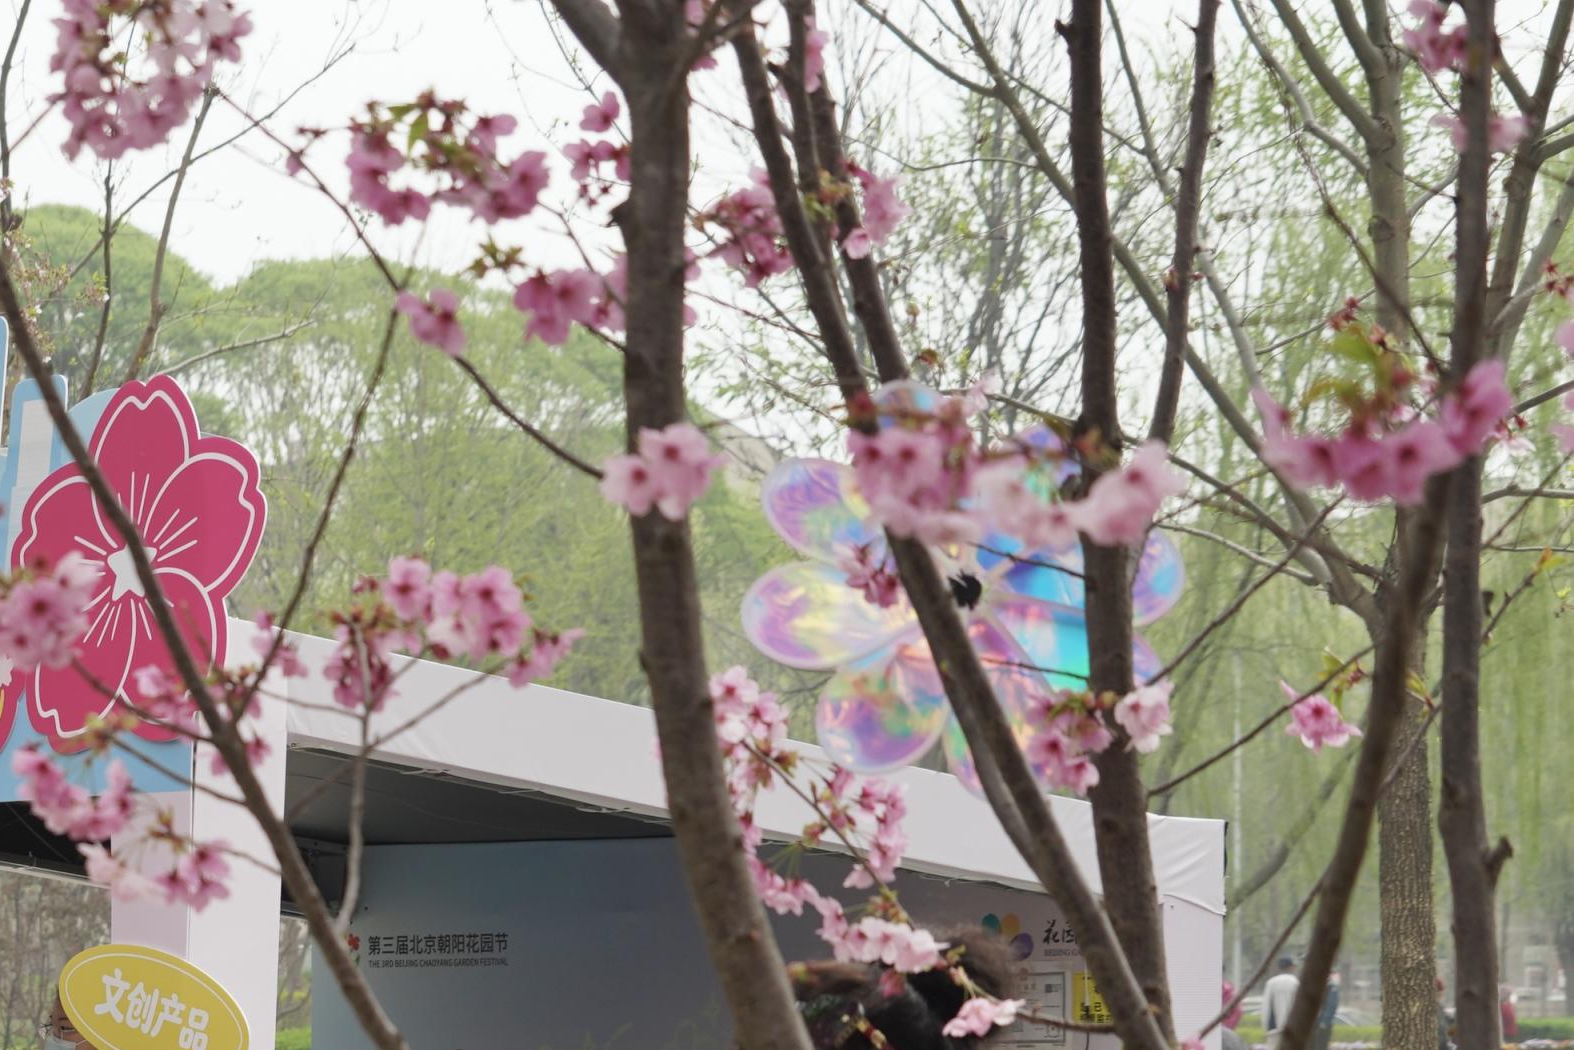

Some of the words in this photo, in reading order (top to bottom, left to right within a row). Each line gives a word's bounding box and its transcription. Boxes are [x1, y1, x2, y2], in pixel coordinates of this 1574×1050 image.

[368, 933, 509, 955] 第三届北京朝阳花园节
[369, 959, 381, 968] THE
[382, 959, 394, 968] 3RD
[395, 958, 418, 968] BEIJING
[419, 958, 453, 967] CHAOYANG
[454, 958, 479, 967] GARDEN
[480, 957, 509, 966] FESTIVAL
